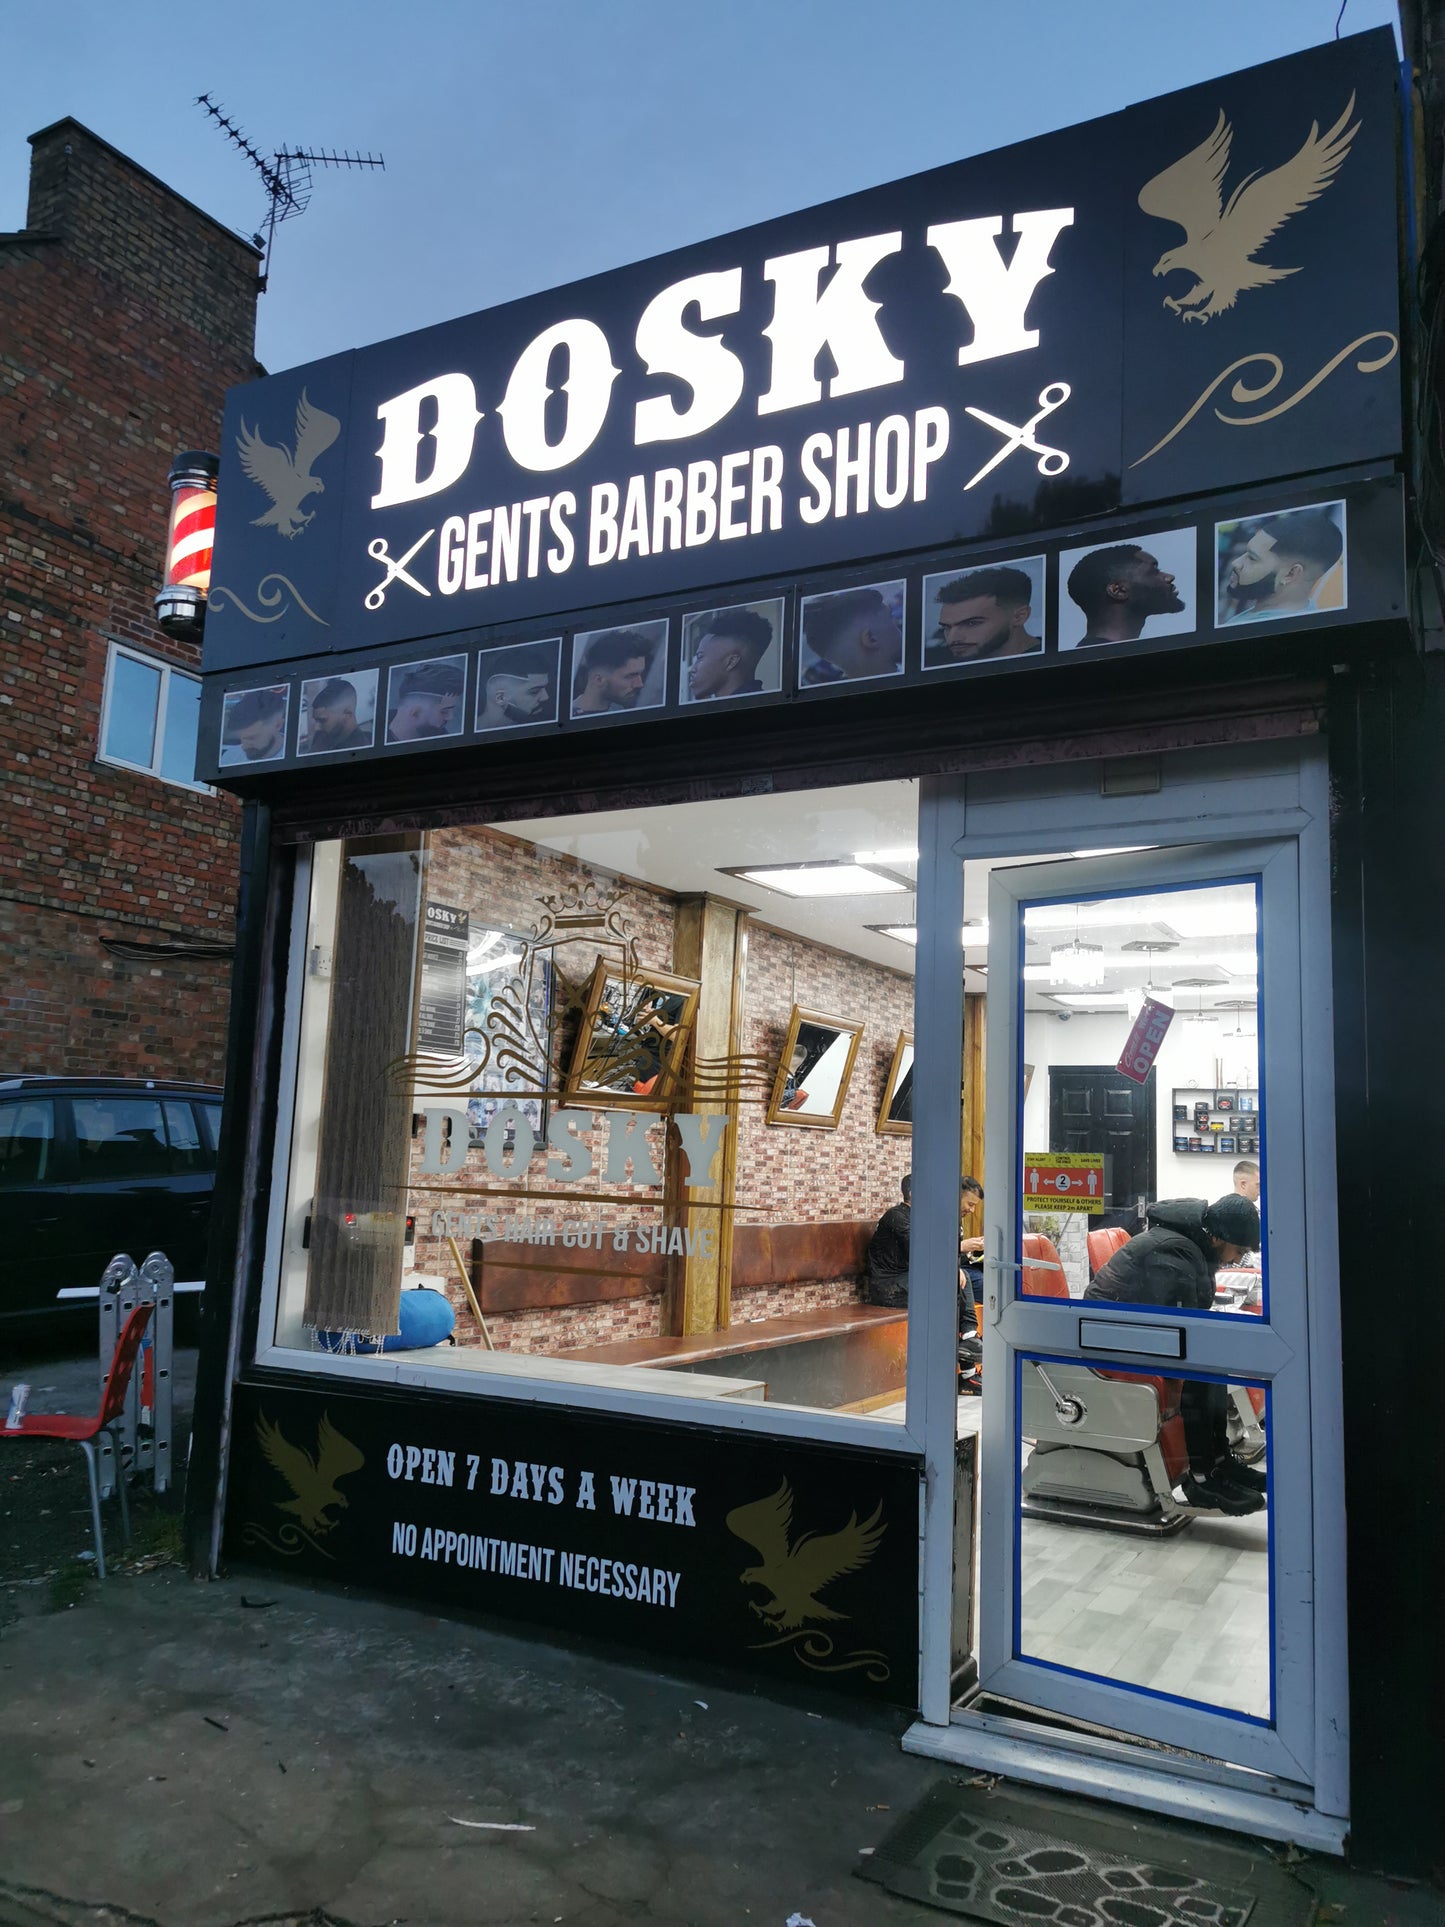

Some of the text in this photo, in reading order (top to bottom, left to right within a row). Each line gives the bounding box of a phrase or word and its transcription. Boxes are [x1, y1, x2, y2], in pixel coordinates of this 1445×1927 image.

[371, 208, 1075, 509] DOSKY
[438, 406, 950, 596] GENTS BARBER SHOP
[1134, 1010, 1171, 1073] OPEN
[419, 1107, 729, 1187] DOSKY
[1060, 1175, 1066, 1185] 2
[432, 1210, 714, 1258] GENTS HAIR CUT & SHAVE
[387, 1443, 697, 1527] OPEN 7 DAYS A WEEK
[392, 1522, 681, 1608] NO APPOINTMENT NECESSARY
